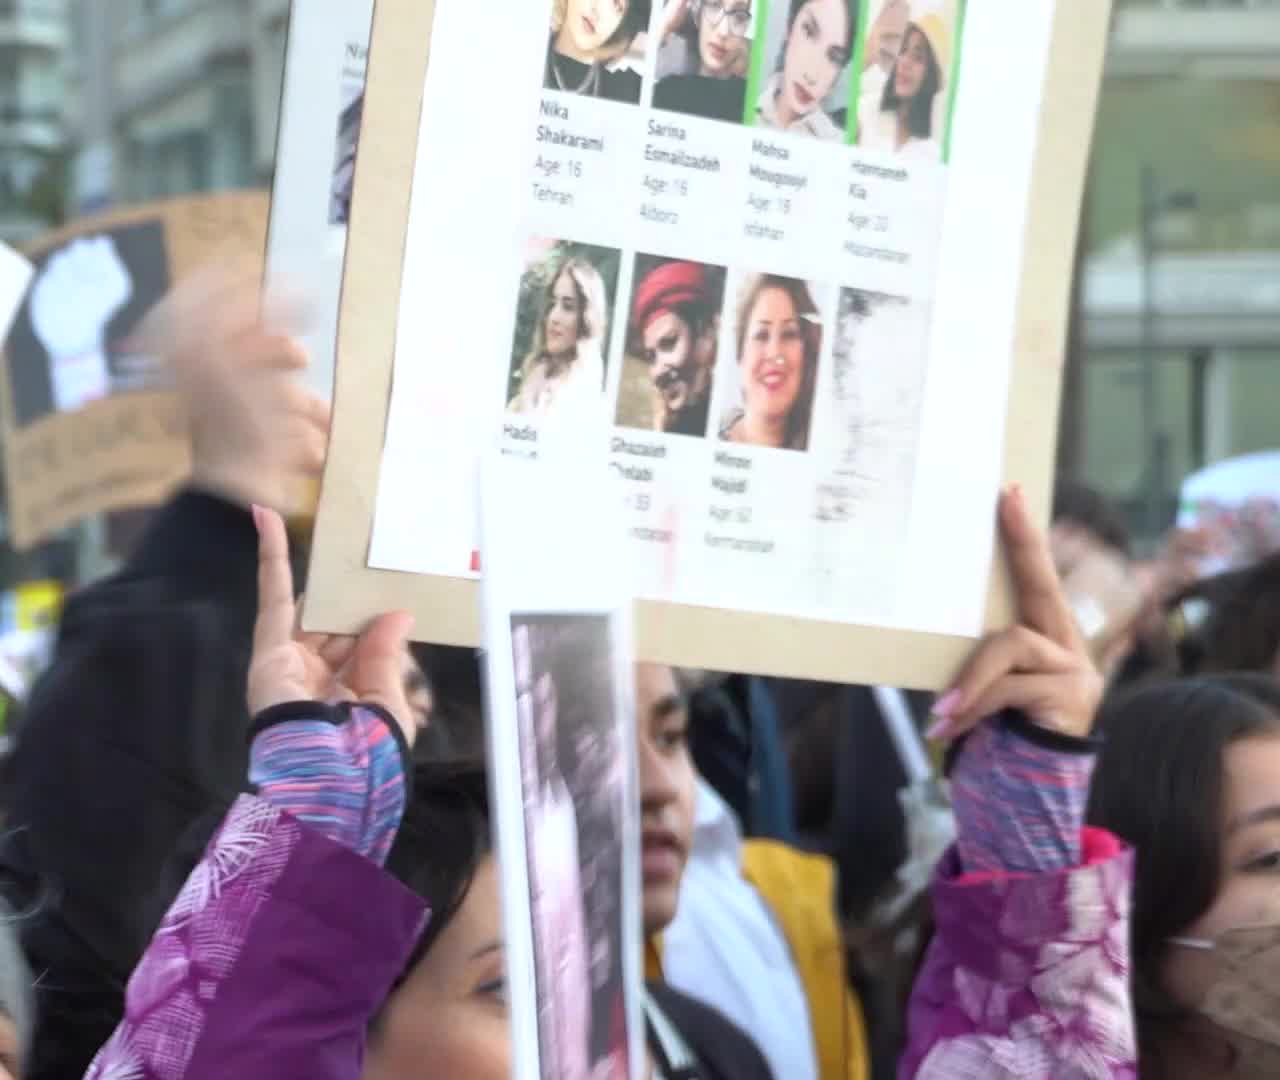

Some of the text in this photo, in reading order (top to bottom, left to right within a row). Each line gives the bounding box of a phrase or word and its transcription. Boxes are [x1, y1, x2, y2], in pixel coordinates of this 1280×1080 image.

[540, 98, 569, 120] Nika
[536, 124, 605, 152] Shakarami
[647, 119, 687, 141] Sarina
